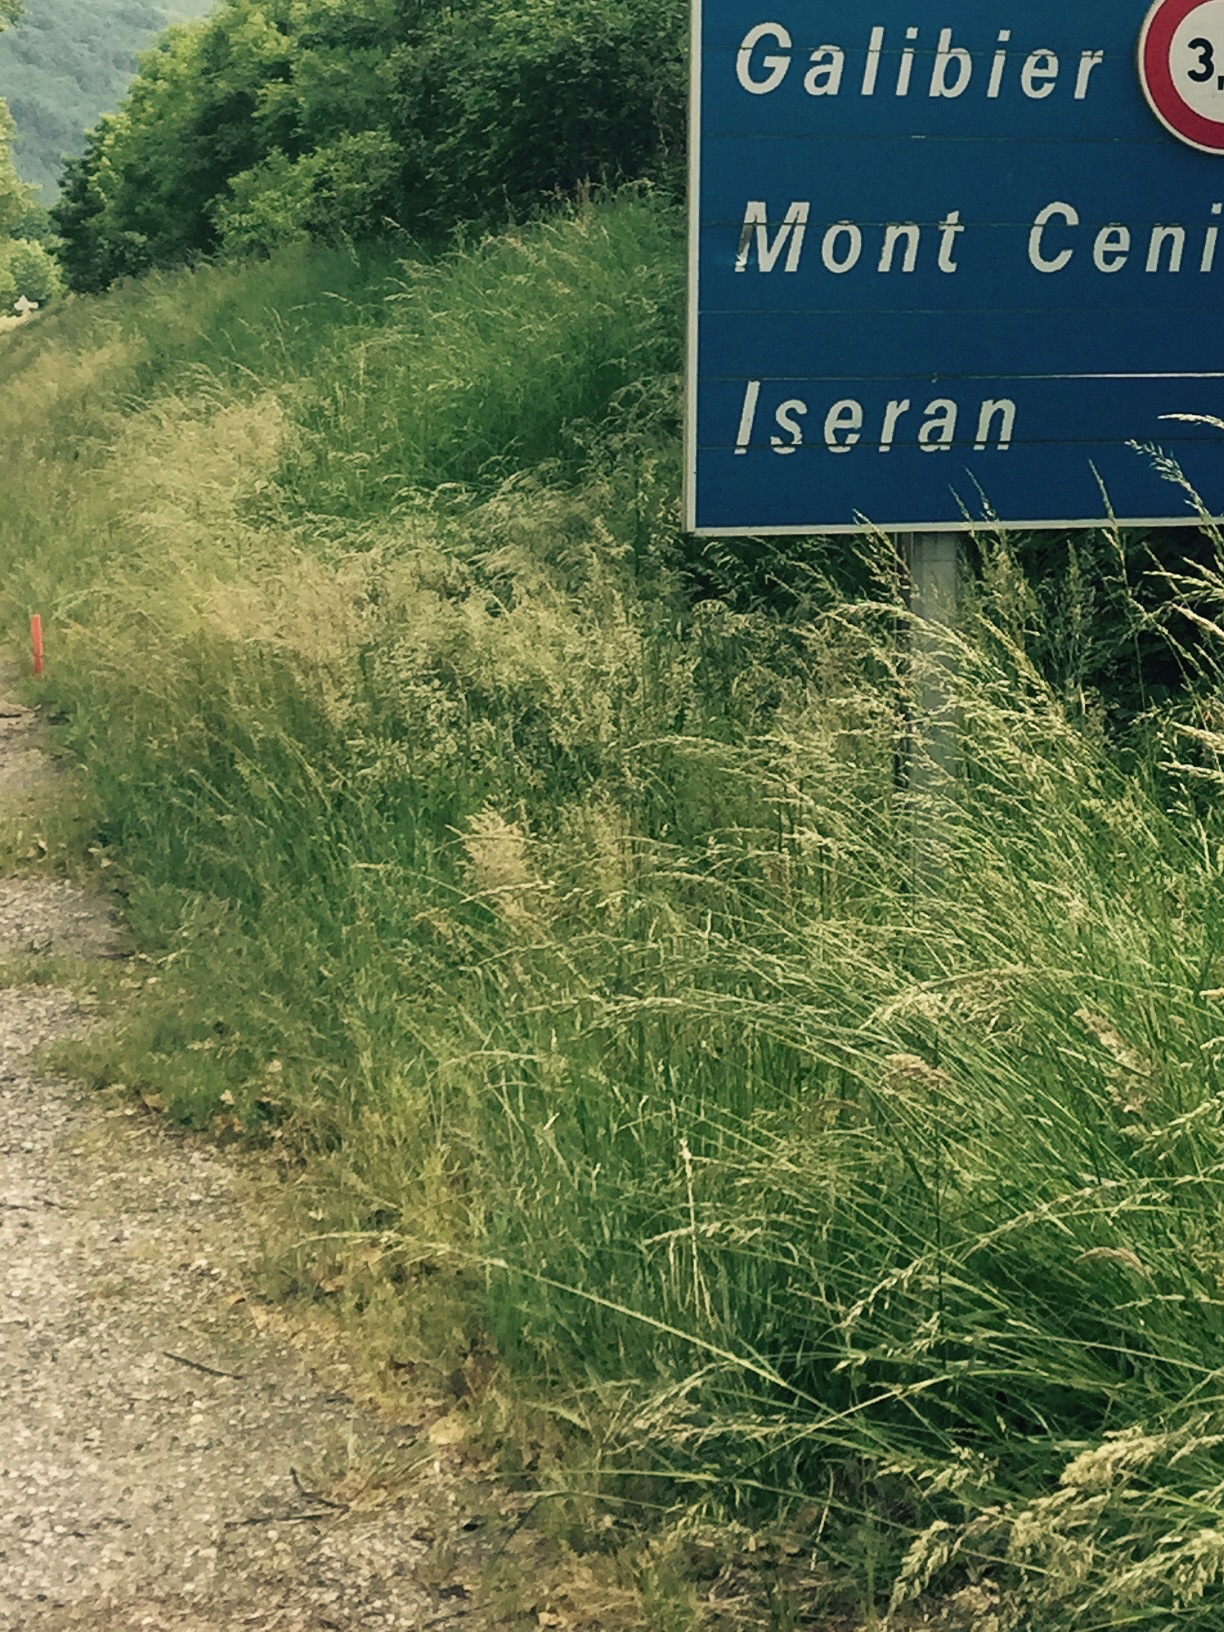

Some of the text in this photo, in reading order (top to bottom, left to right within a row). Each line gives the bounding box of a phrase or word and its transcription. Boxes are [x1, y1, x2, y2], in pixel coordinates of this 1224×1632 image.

[737, 23, 1101, 98] Galibier
[735, 202, 964, 272] Mont
[735, 382, 1015, 453] Iseran
